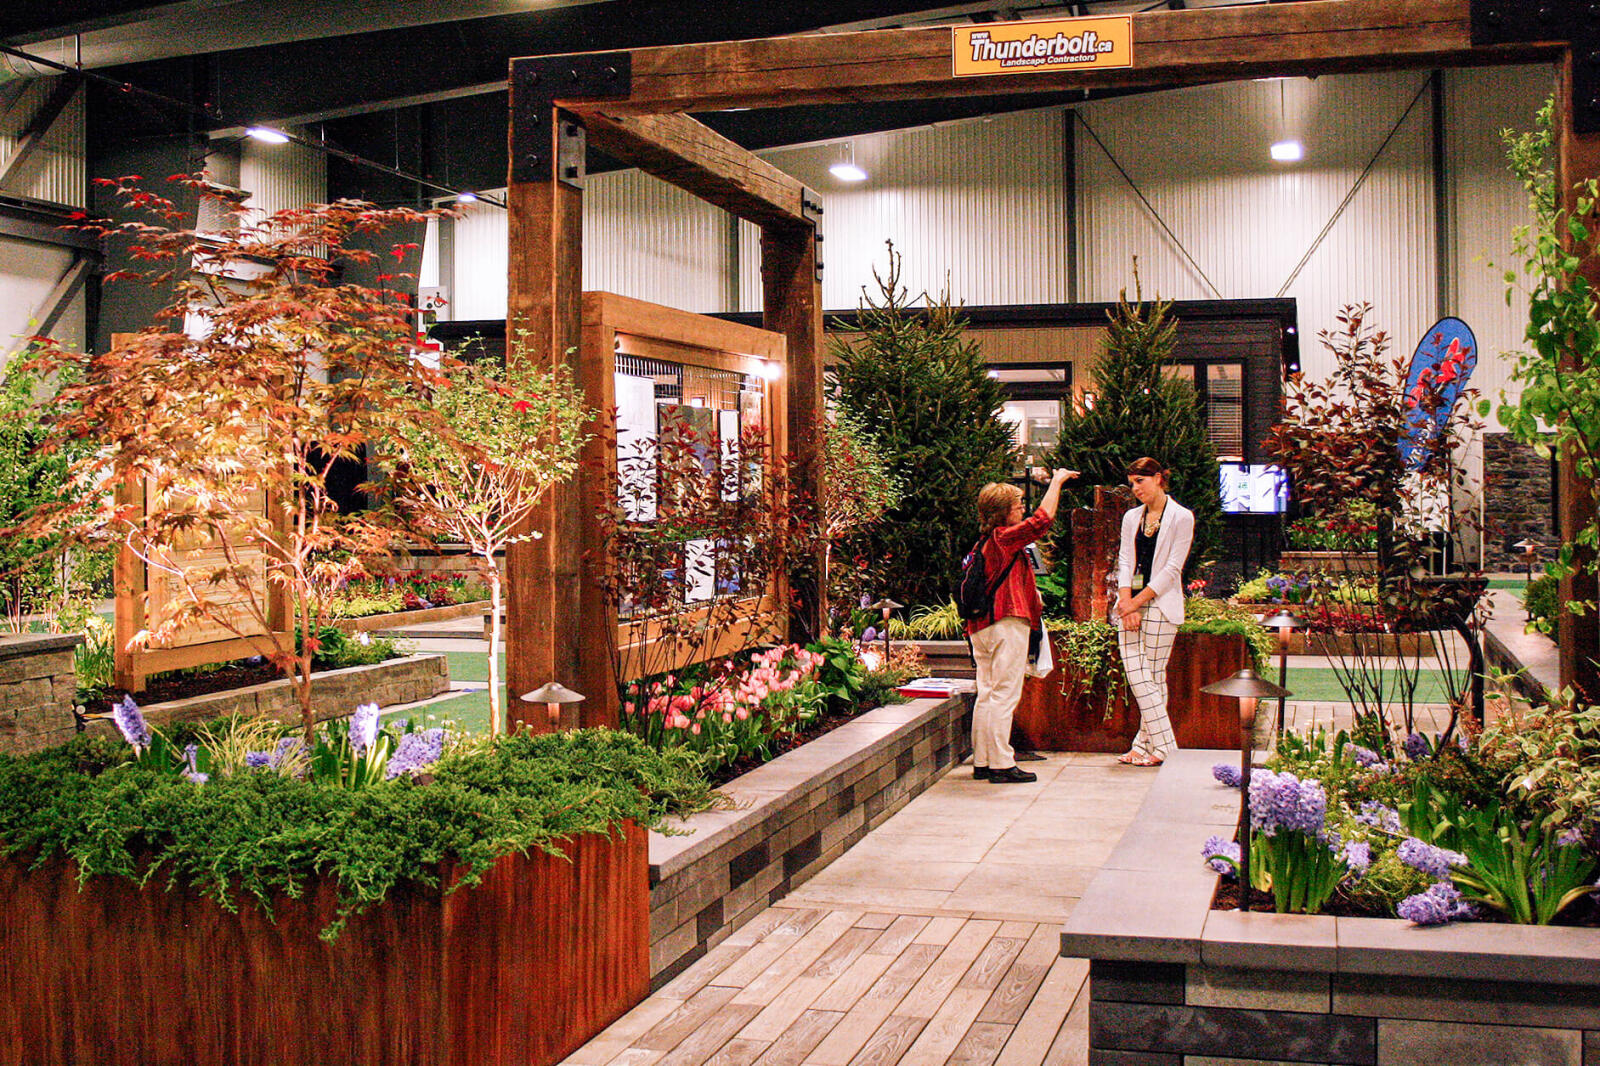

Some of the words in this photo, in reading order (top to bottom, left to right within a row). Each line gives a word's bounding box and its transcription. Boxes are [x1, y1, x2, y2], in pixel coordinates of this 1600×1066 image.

[971, 32, 988, 40] www
[970, 31, 1113, 61] Thunderbolt.ca
[1001, 58, 1046, 67] Landscape
[1047, 55, 1096, 64] Contractors
